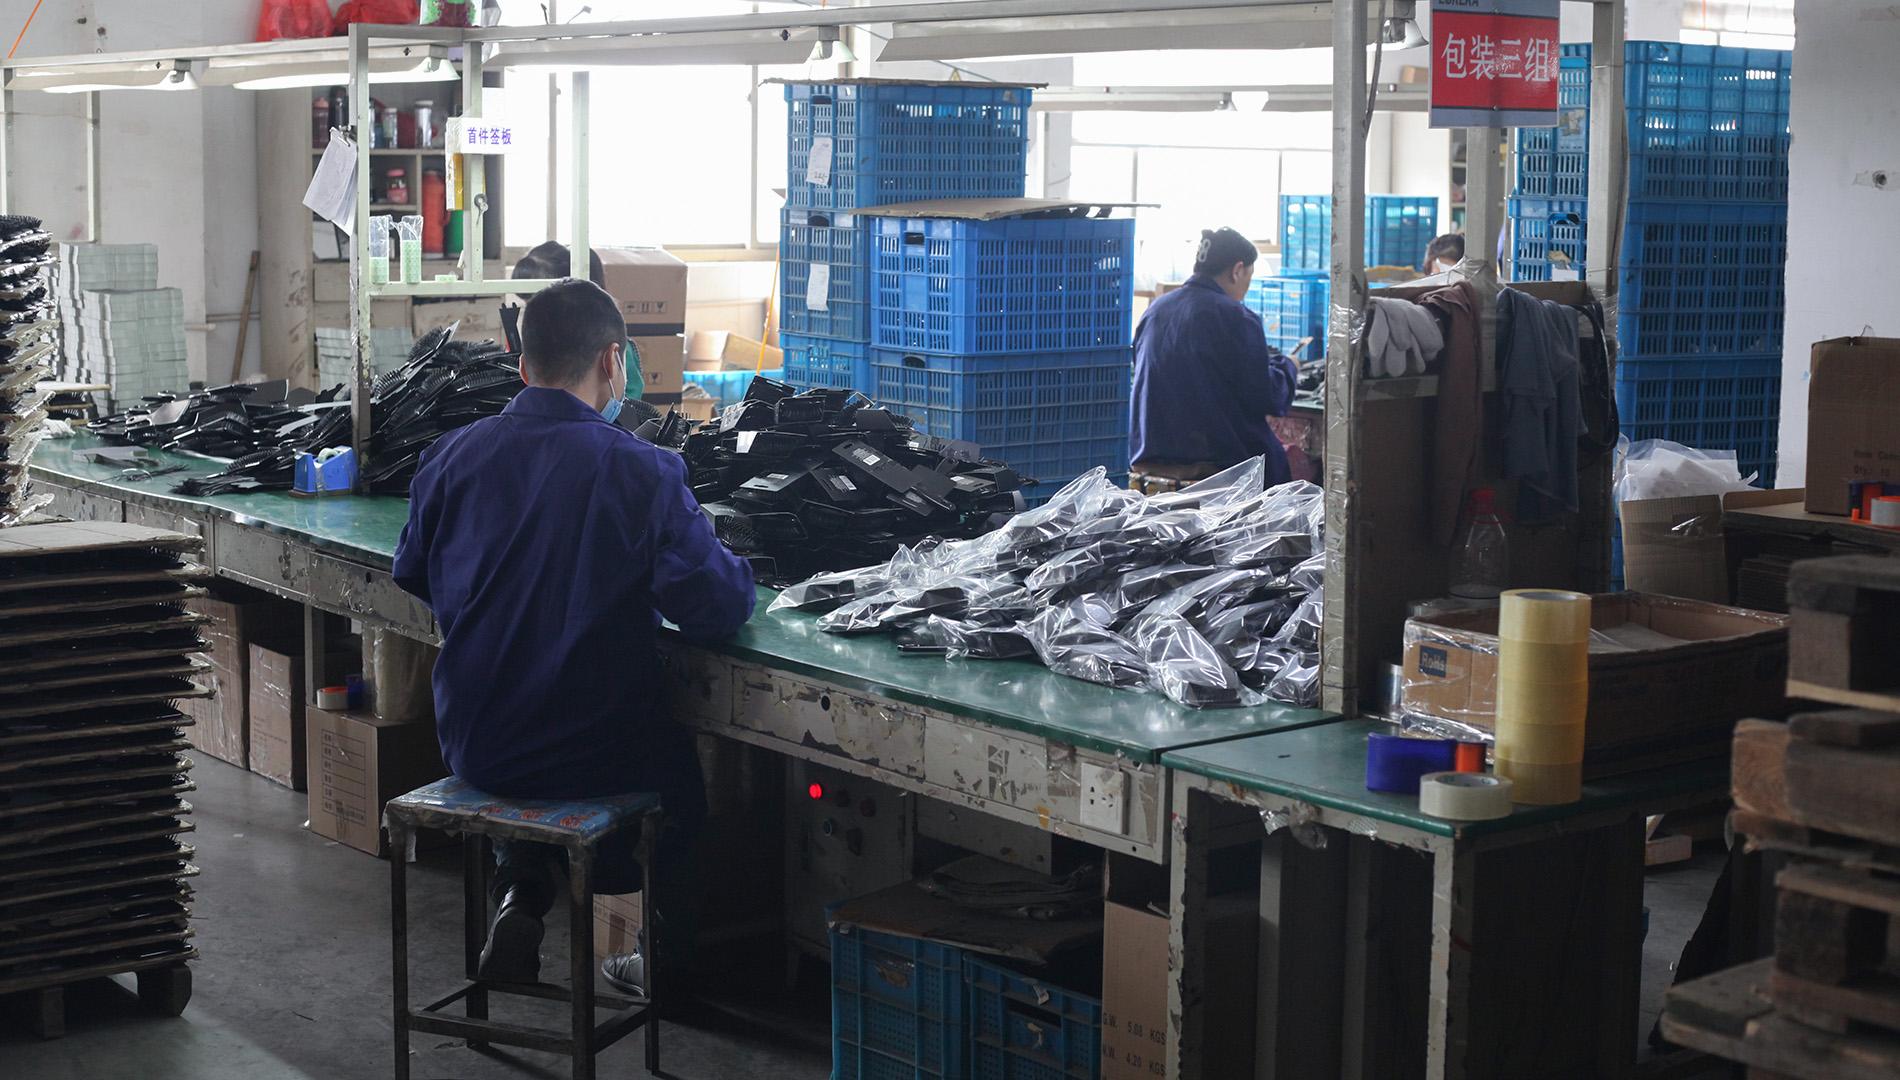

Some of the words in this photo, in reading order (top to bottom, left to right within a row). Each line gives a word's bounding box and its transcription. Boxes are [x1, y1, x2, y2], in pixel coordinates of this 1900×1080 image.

[1441, 32, 1551, 81] 包装三组
[467, 127, 512, 144] 首件签板
